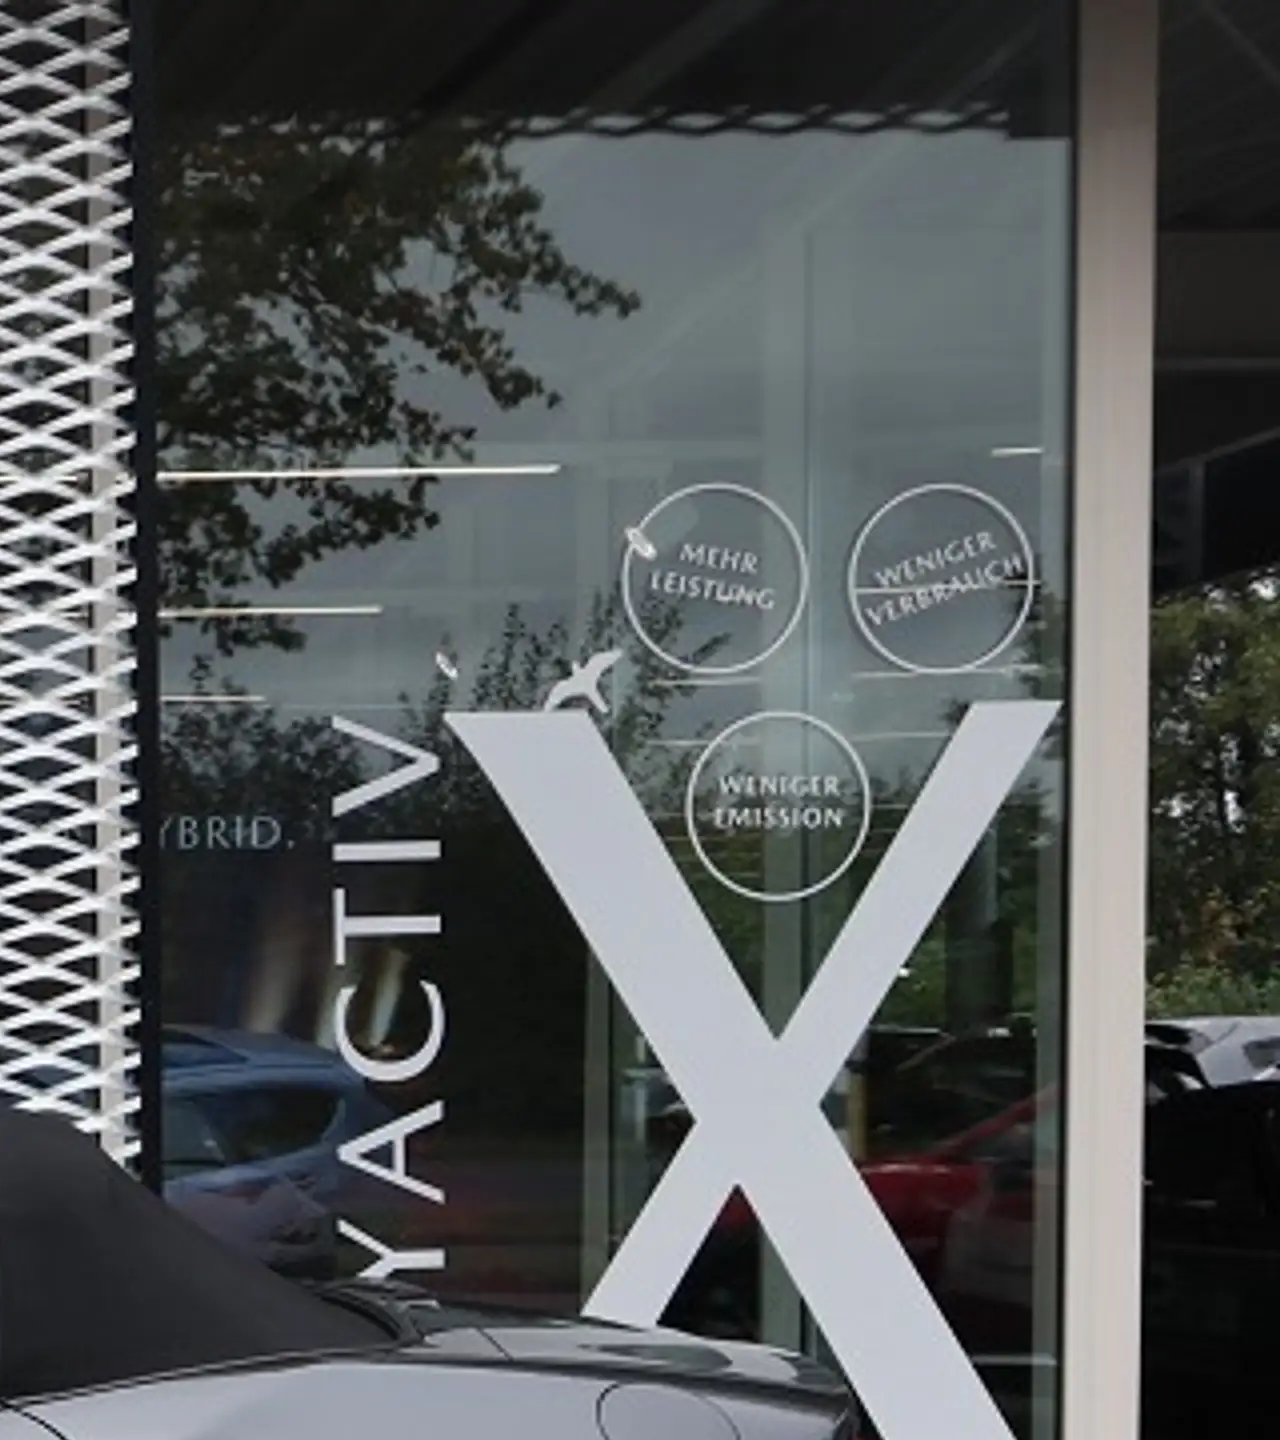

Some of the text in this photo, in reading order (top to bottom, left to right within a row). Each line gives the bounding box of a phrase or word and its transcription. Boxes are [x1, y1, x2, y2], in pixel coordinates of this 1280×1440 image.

[679, 541, 760, 575] MEHR
[874, 530, 997, 590] WENIGER
[649, 570, 776, 612] LEISTUNG
[865, 554, 1024, 628] VERBRAUCH
[719, 774, 840, 798] WENIGER
[159, 814, 296, 850] YBRID.
[714, 806, 844, 830] EMISSION
[332, 715, 445, 1278] YACTIV
